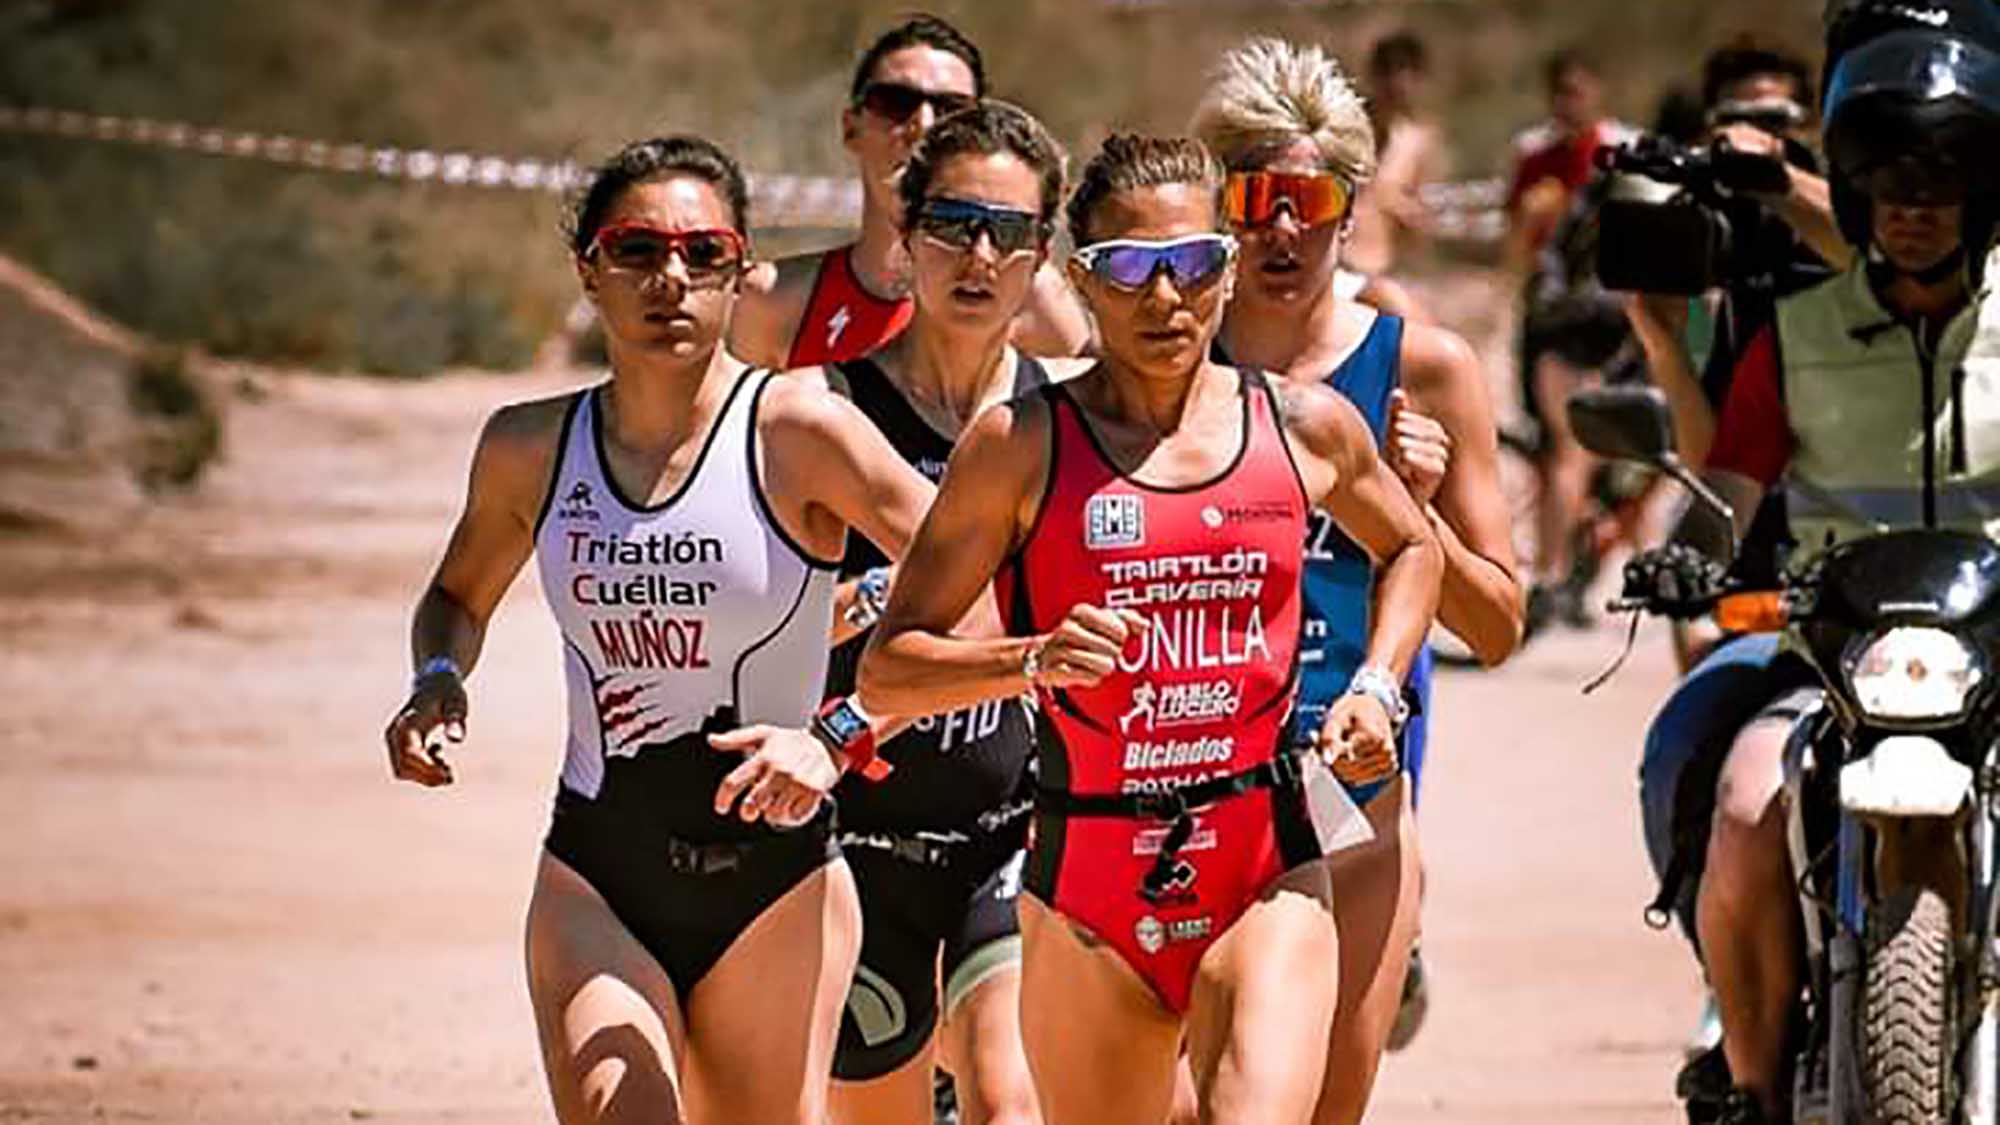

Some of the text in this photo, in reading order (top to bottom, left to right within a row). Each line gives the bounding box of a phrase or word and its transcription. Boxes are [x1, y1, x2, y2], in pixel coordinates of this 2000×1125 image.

[567, 531, 722, 565] Triatlón
[572, 573, 716, 606] Cuéllar
[591, 609, 710, 669] MUÑOZ
[1117, 604, 1271, 673] ONILLA
